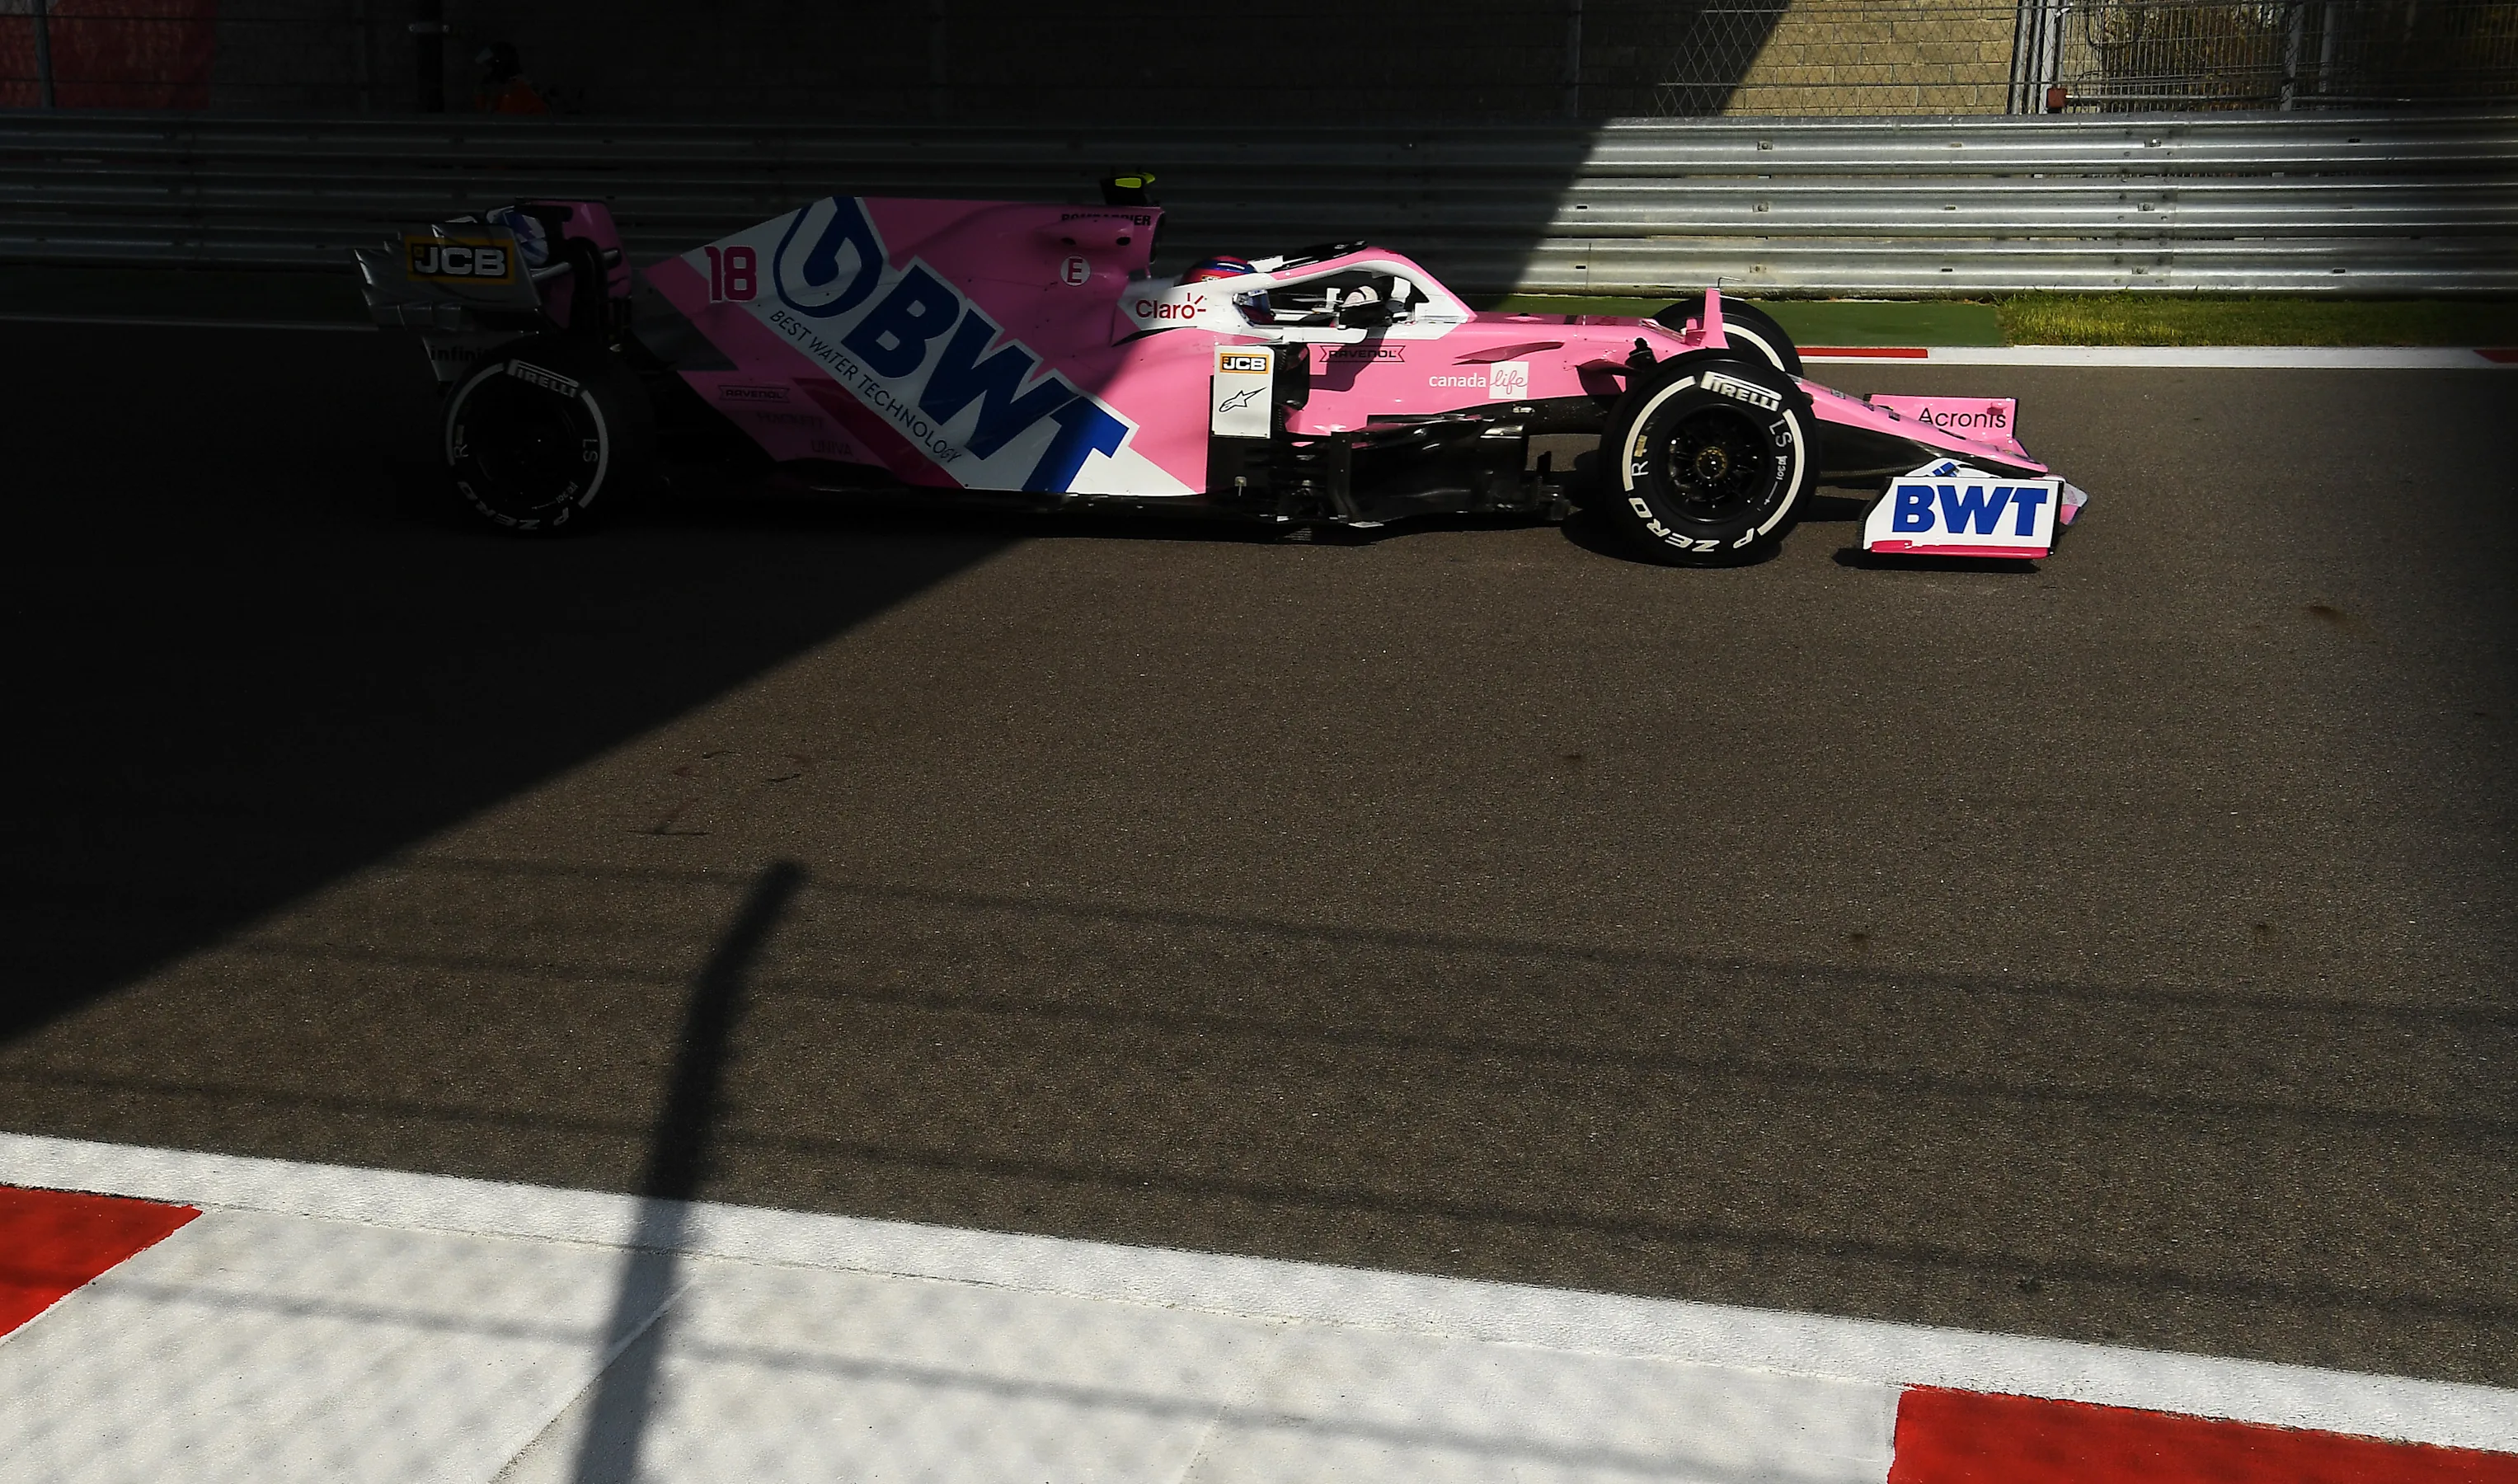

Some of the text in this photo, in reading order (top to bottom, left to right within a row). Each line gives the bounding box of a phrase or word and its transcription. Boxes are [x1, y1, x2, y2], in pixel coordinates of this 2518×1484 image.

[414, 247, 506, 276] JCB
[705, 246, 757, 302] 18
[1067, 258, 1083, 284] E
[1136, 299, 1196, 319] Claro
[1224, 357, 1266, 371] JCB
[1329, 350, 1397, 359] RAVENOL
[506, 358, 580, 399] PIRELLI
[770, 311, 962, 463] BEST WATER TECHNOLOGY
[841, 264, 1130, 493] BWT
[1429, 369, 1528, 395] canada life
[1699, 370, 1783, 412] PIRELLI
[1919, 407, 2007, 429] Acronis
[1628, 496, 1755, 553] P ZERO
[1892, 485, 2048, 536] BWT
